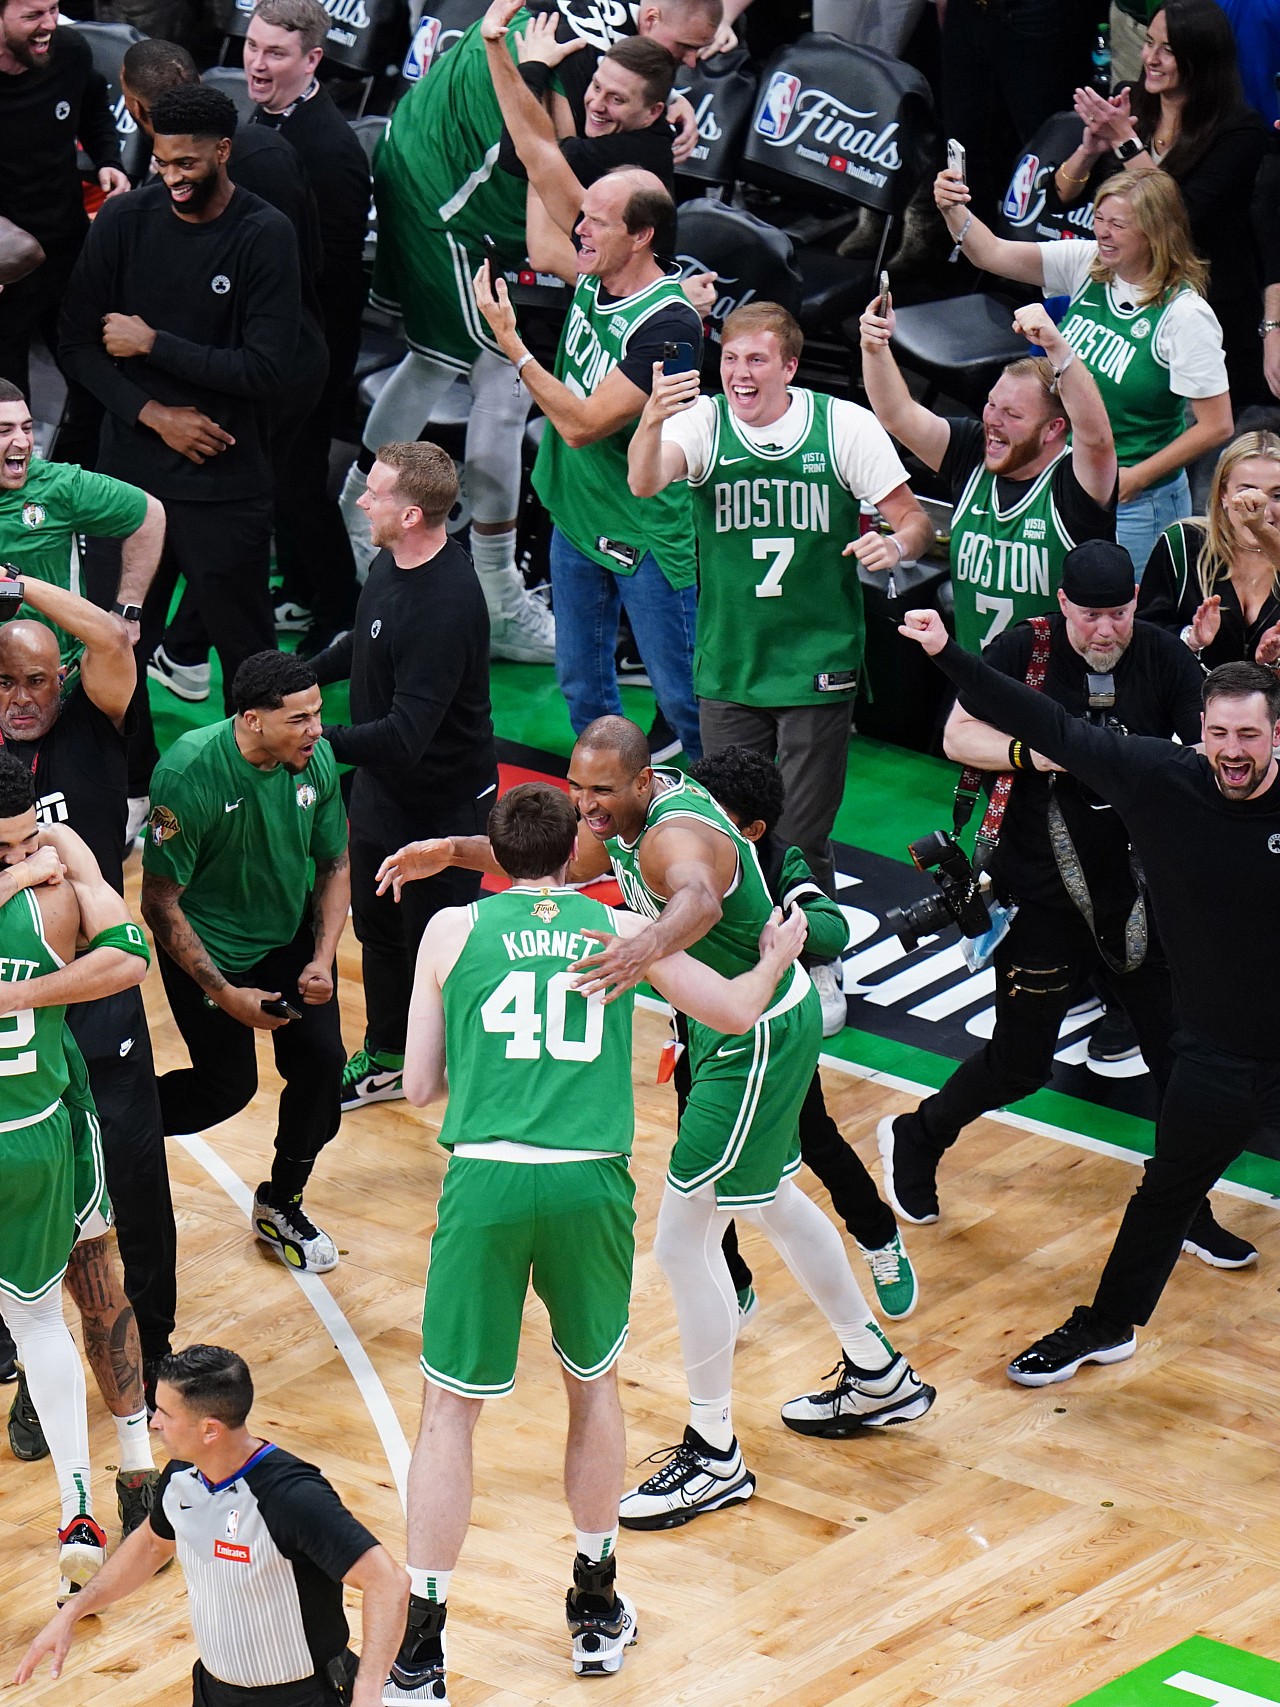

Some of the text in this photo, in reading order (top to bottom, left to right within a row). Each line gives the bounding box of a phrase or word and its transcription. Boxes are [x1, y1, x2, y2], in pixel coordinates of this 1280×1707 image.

[764, 89, 902, 170] Finals
[1060, 314, 1137, 385] BOSTON
[802, 452, 826, 463] VISTA
[803, 463, 826, 473] PRINT
[714, 478, 830, 533] BOSTON
[1023, 530, 1046, 540] PRINT
[1024, 518, 1046, 531] VISTA
[752, 537, 795, 598] 7
[957, 531, 1050, 597] BOSTON
[975, 592, 1014, 651] 7
[148, 807, 180, 832] Finals
[531, 903, 559, 915] Finals
[501, 929, 600, 961] KORNET
[480, 970, 606, 1063] 40
[217, 1544, 247, 1559] Emirates
